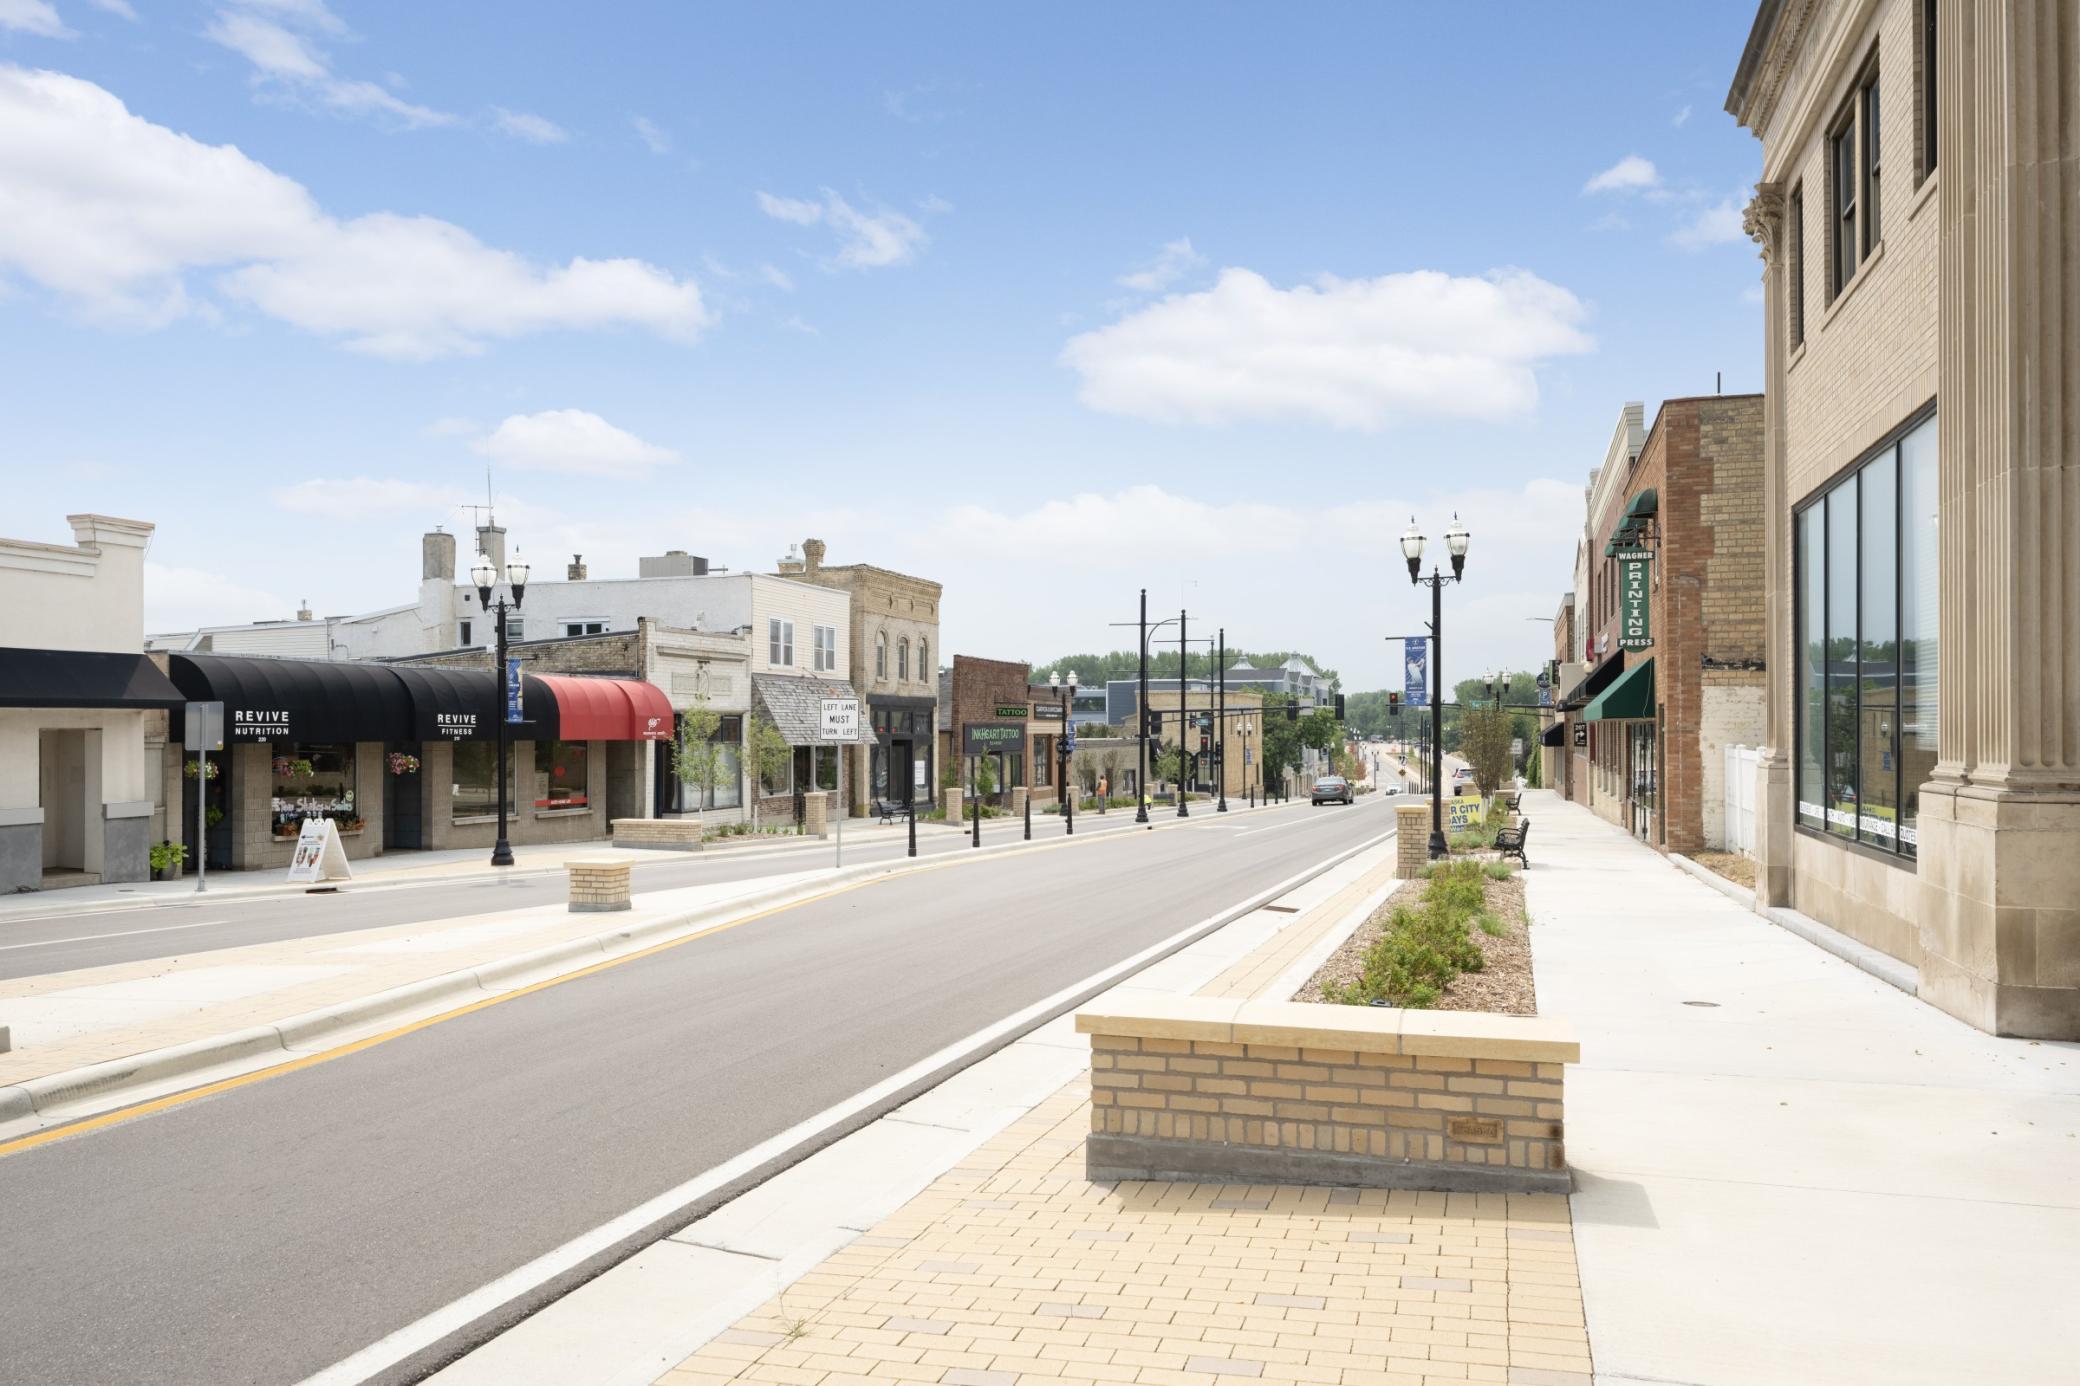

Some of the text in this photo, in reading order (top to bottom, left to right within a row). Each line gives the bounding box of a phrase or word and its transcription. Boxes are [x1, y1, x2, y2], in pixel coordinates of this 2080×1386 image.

[1618, 552, 1653, 560] WAGNER
[1628, 562, 1643, 636] PRINTING
[1619, 638, 1653, 646] PRESS
[823, 703, 857, 711] LEFT LANE
[235, 711, 289, 722] REVIVE
[998, 708, 1027, 716] TATTOO
[437, 714, 477, 724] REVIVE
[829, 715, 849, 724] MUST
[235, 727, 289, 735] NUTRITION
[822, 727, 858, 736] TURN LEFT
[1459, 803, 1480, 814] CITY
[1450, 815, 1468, 824] AYS
